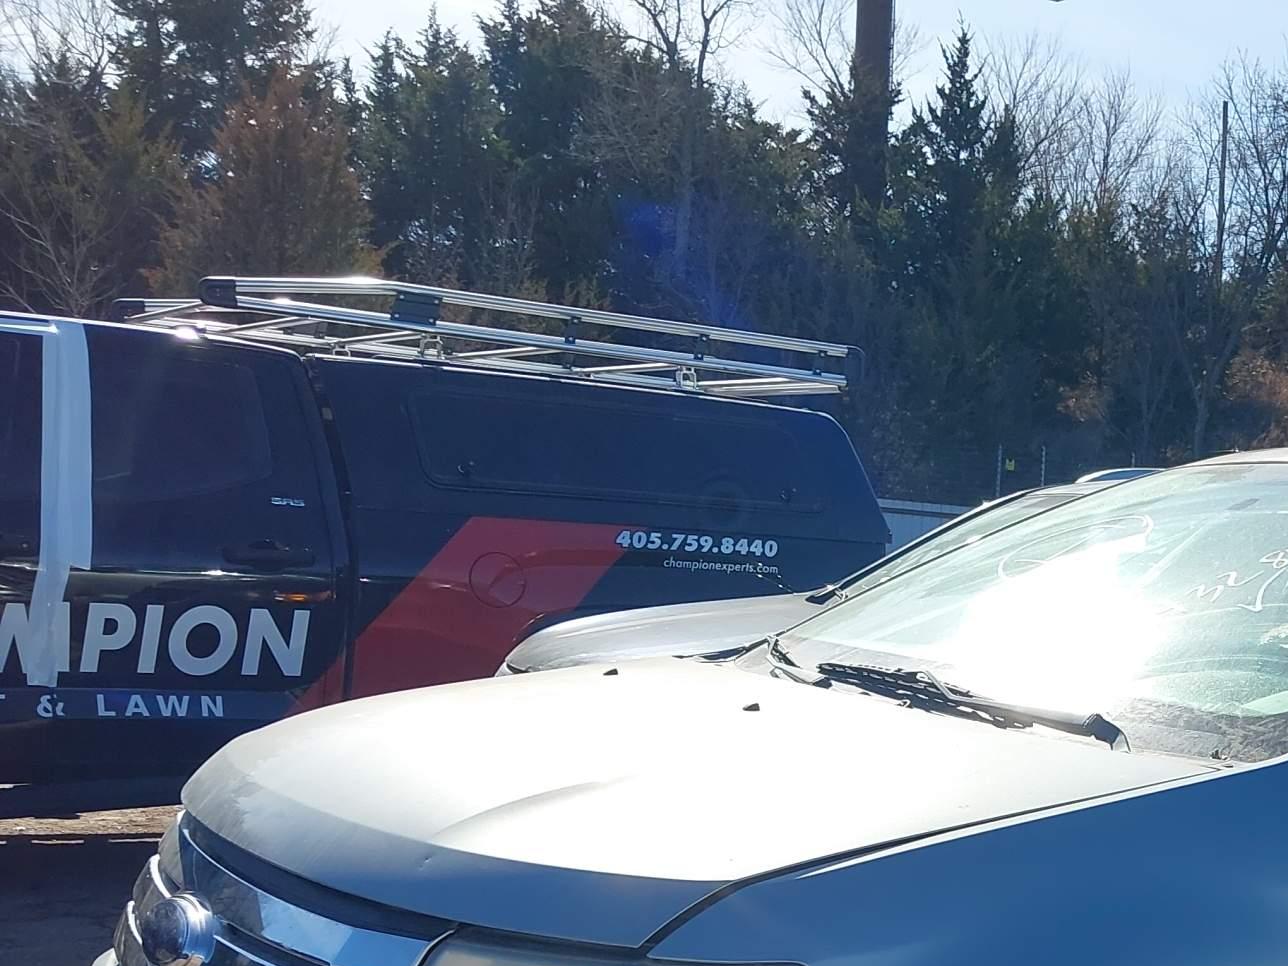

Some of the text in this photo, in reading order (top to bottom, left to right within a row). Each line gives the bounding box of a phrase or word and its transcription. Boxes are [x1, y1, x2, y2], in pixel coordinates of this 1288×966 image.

[615, 530, 778, 558] 405.759.8440
[663, 556, 778, 575] championexperts.com
[96, 693, 224, 717] LAWN
